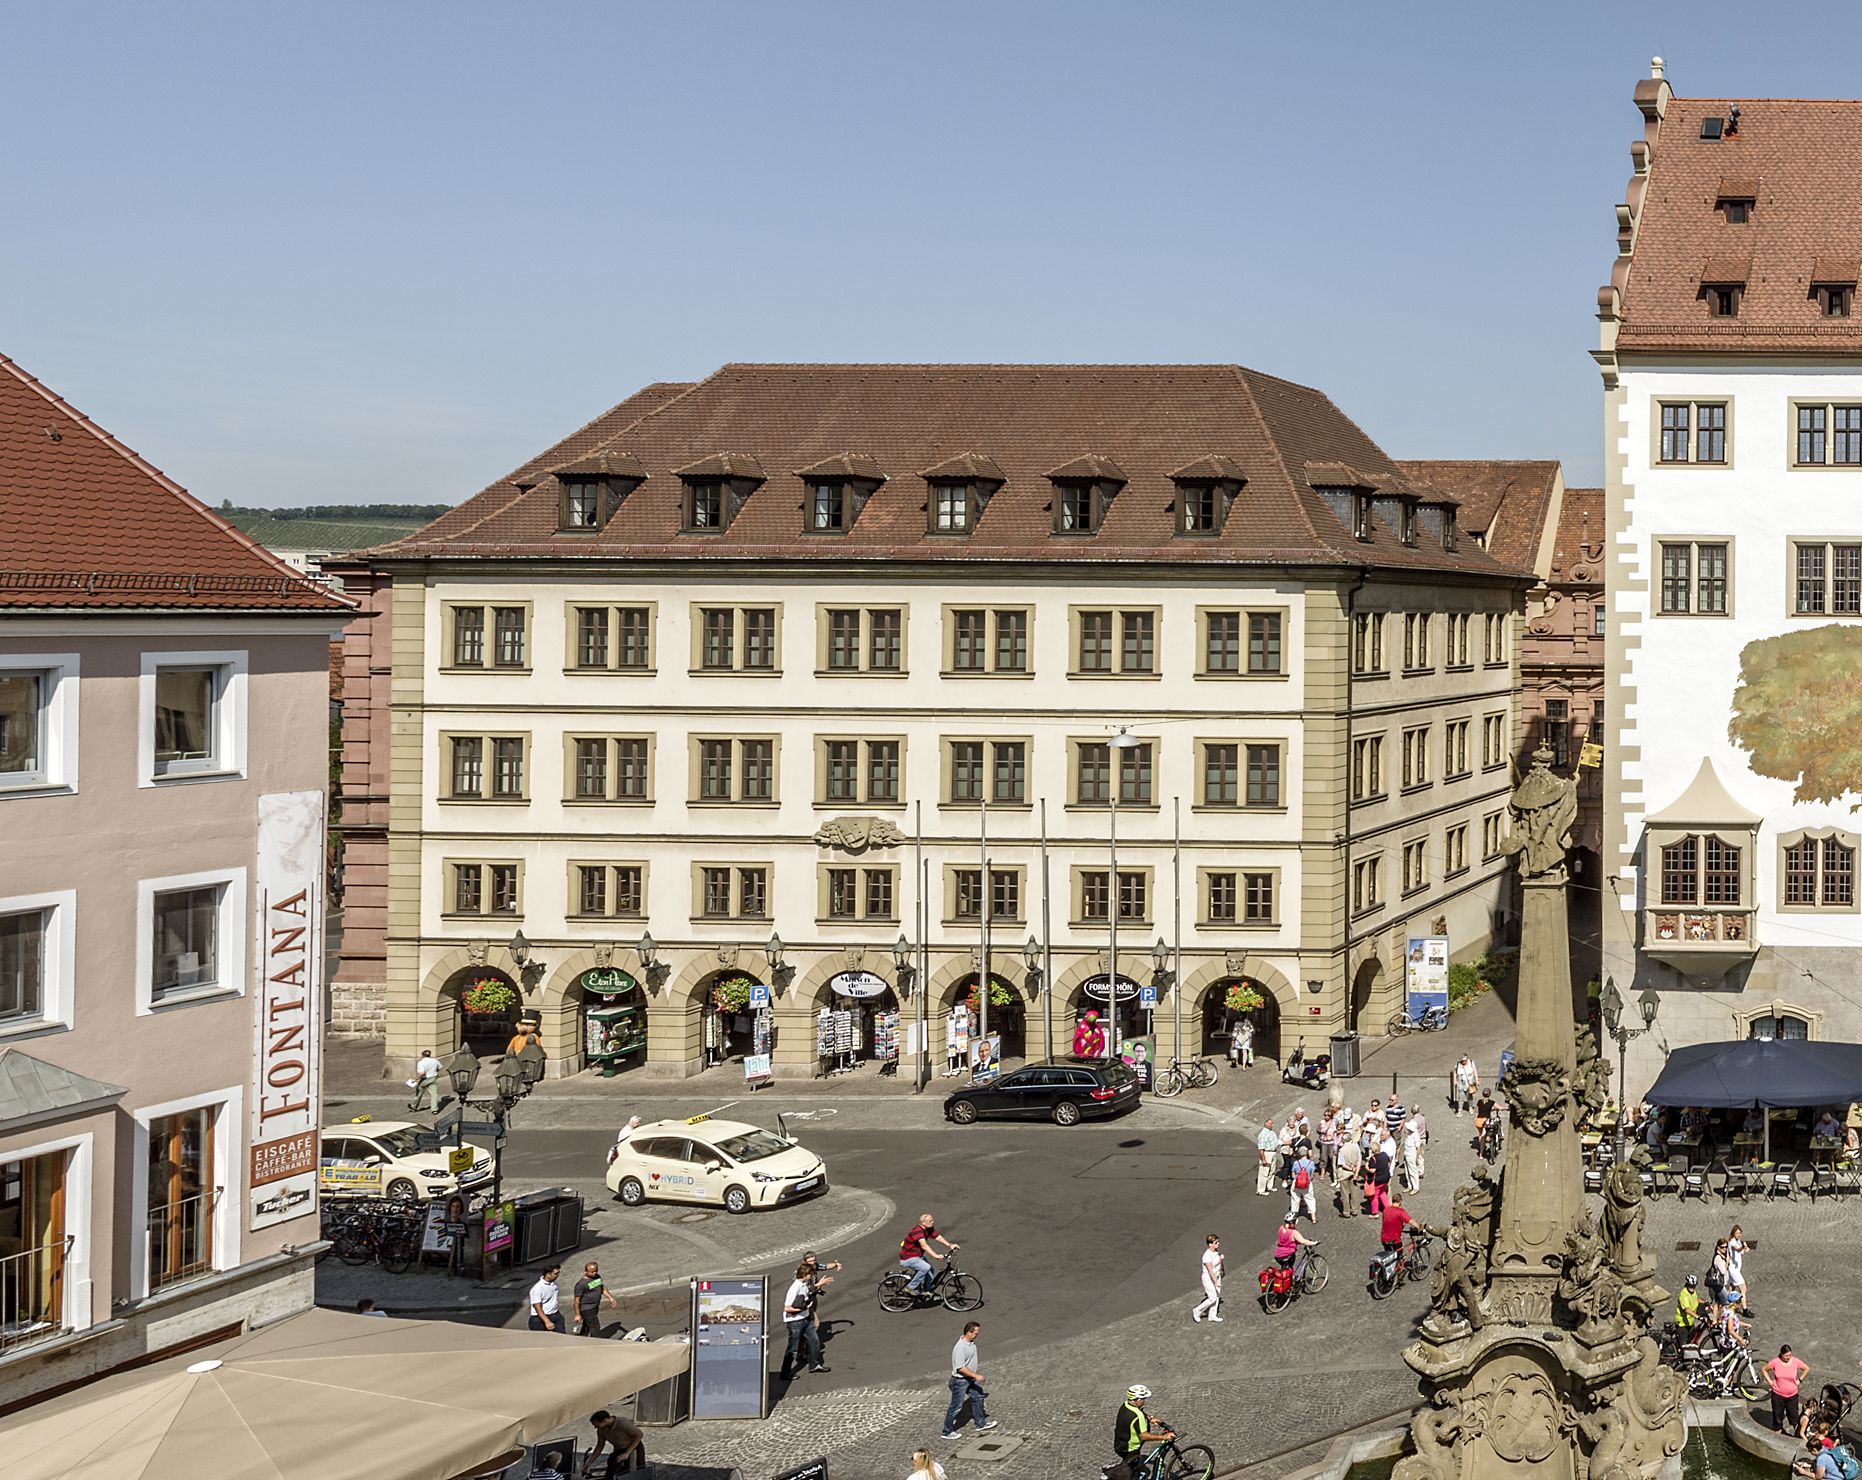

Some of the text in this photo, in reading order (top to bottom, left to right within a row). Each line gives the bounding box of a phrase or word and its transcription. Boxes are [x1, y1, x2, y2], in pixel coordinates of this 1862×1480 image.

[259, 888, 309, 1124] FONTANA
[256, 1136, 312, 1161] EISCAFÉ
[255, 1159, 311, 1180] BISTRORANTE
[661, 1175, 694, 1185] HYBRID
[262, 1194, 304, 1212] Tucher
